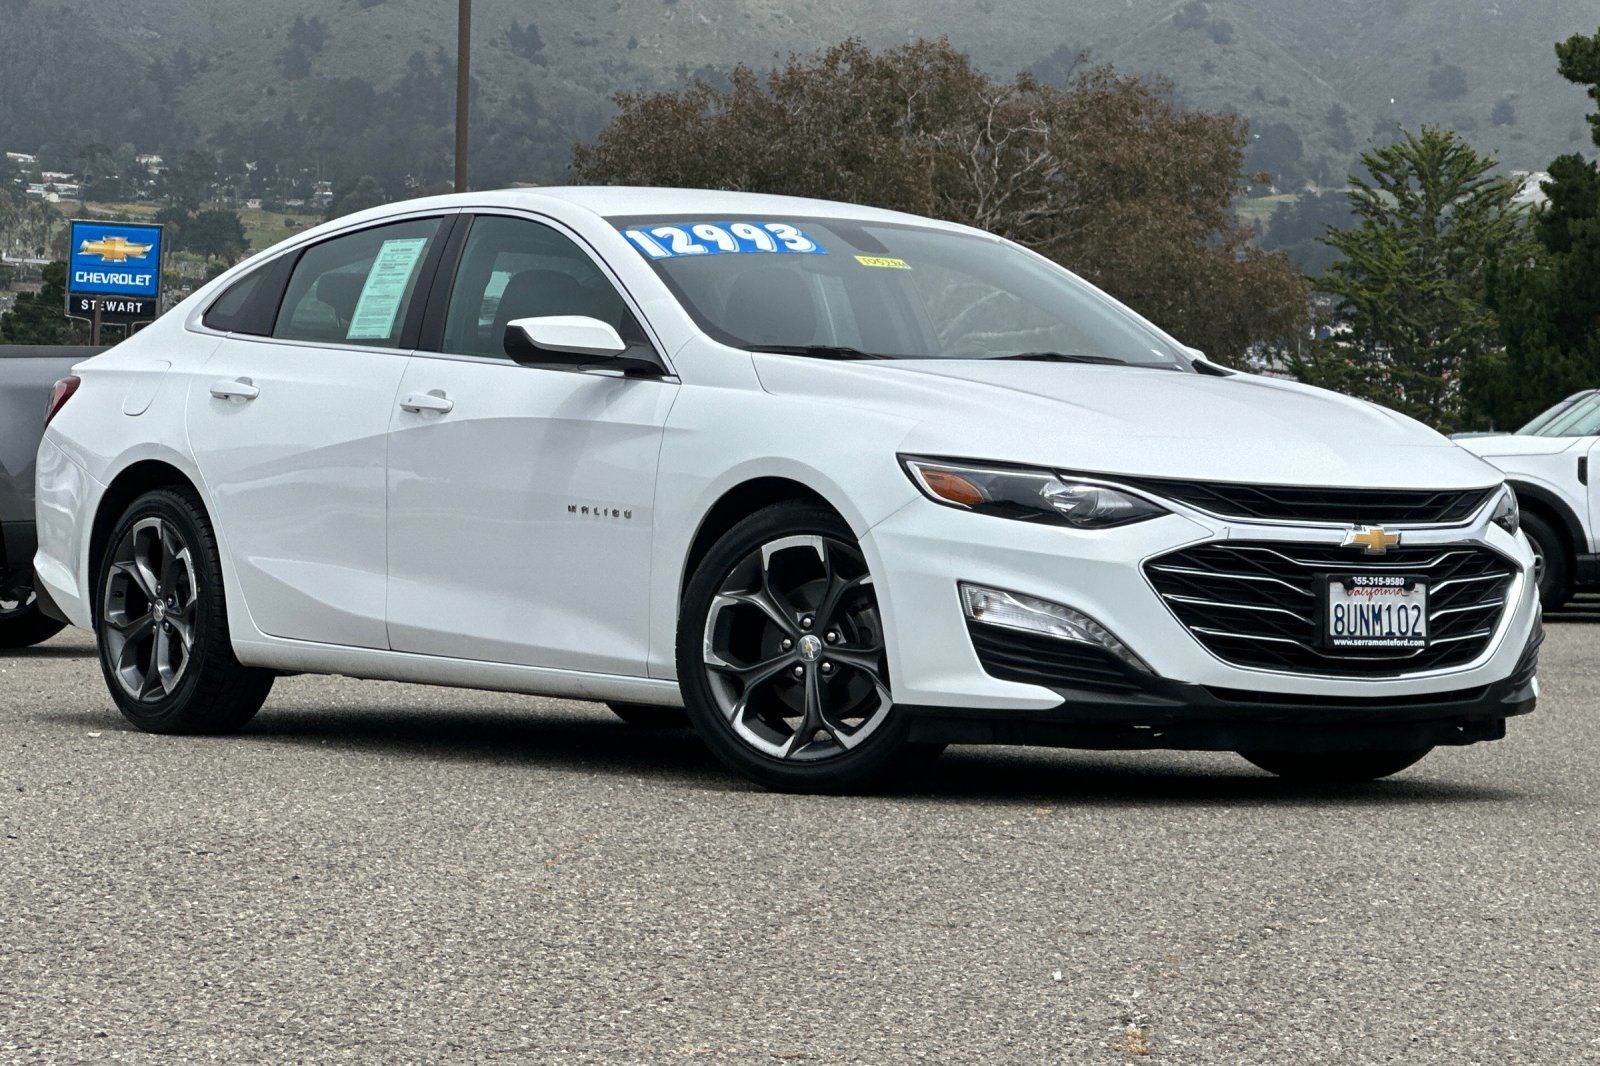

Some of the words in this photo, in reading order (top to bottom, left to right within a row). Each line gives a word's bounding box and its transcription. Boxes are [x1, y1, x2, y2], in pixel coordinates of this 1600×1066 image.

[625, 222, 817, 258] 12993
[75, 271, 152, 286] CHEVROLET
[1334, 603, 1423, 636] 8UNM102
[1333, 638, 1425, 647] www.serramonteford.com
